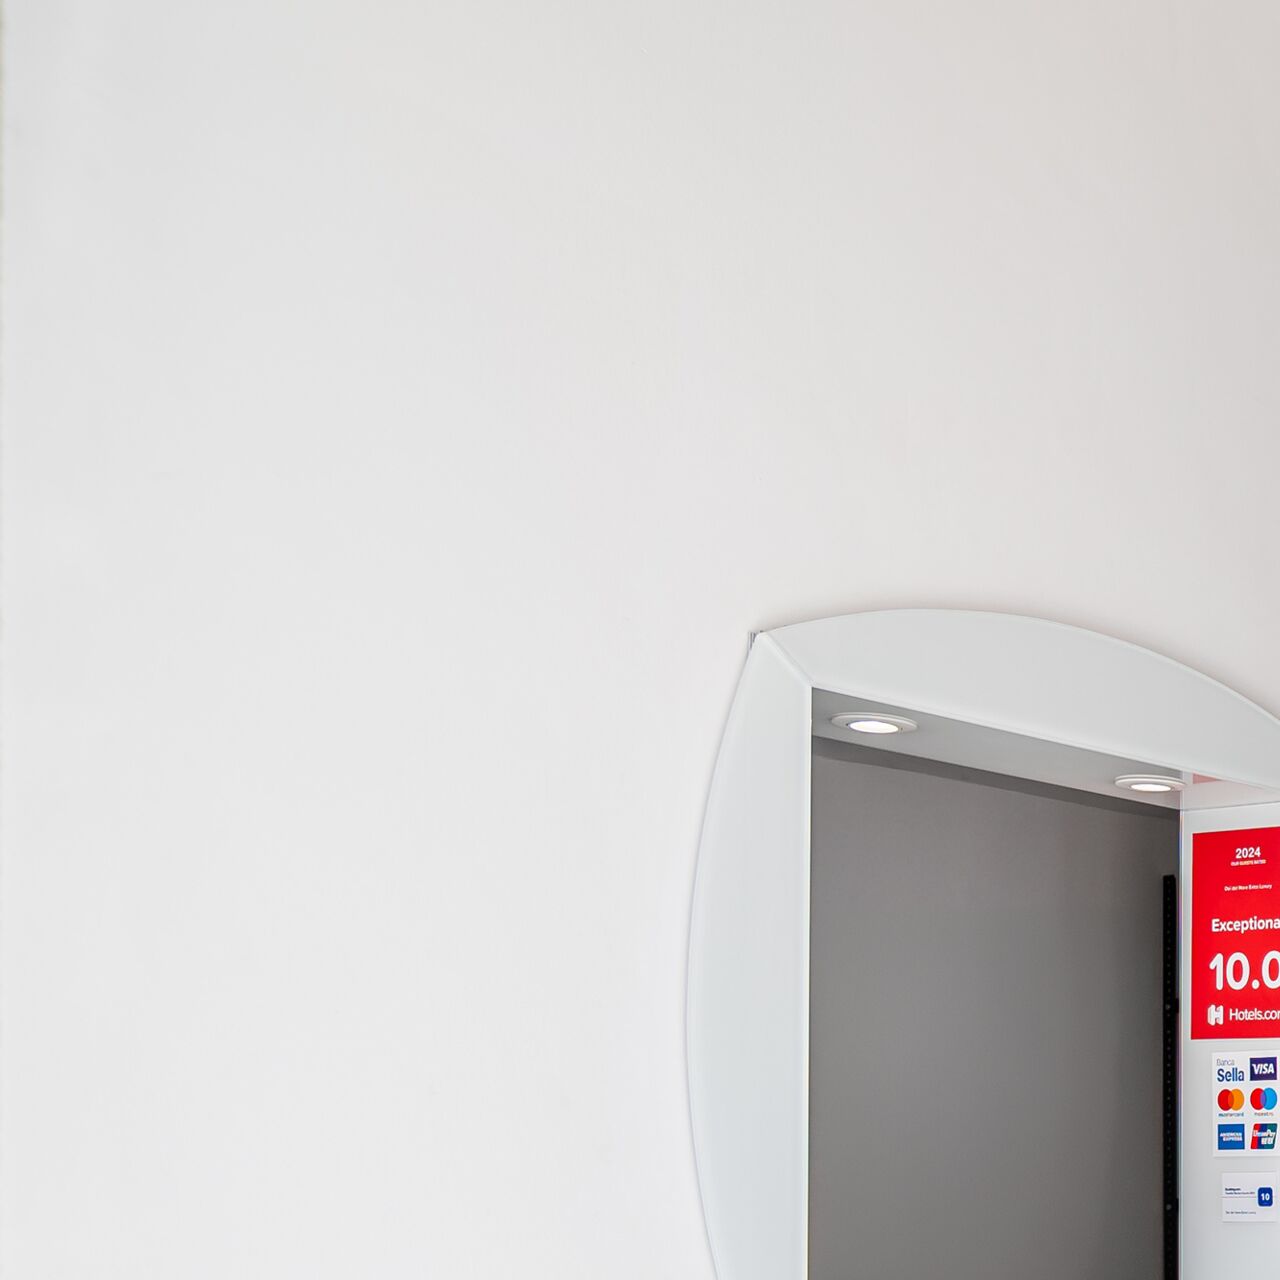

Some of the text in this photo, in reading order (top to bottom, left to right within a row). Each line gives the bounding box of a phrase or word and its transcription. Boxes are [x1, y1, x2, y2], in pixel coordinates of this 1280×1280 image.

[1235, 846, 1261, 859] 2024
[1216, 1058, 1235, 1066] Banca
[1251, 1062, 1275, 1074] VISA
[1216, 1067, 1245, 1082] Sella
[1260, 1192, 1271, 1201] 10
